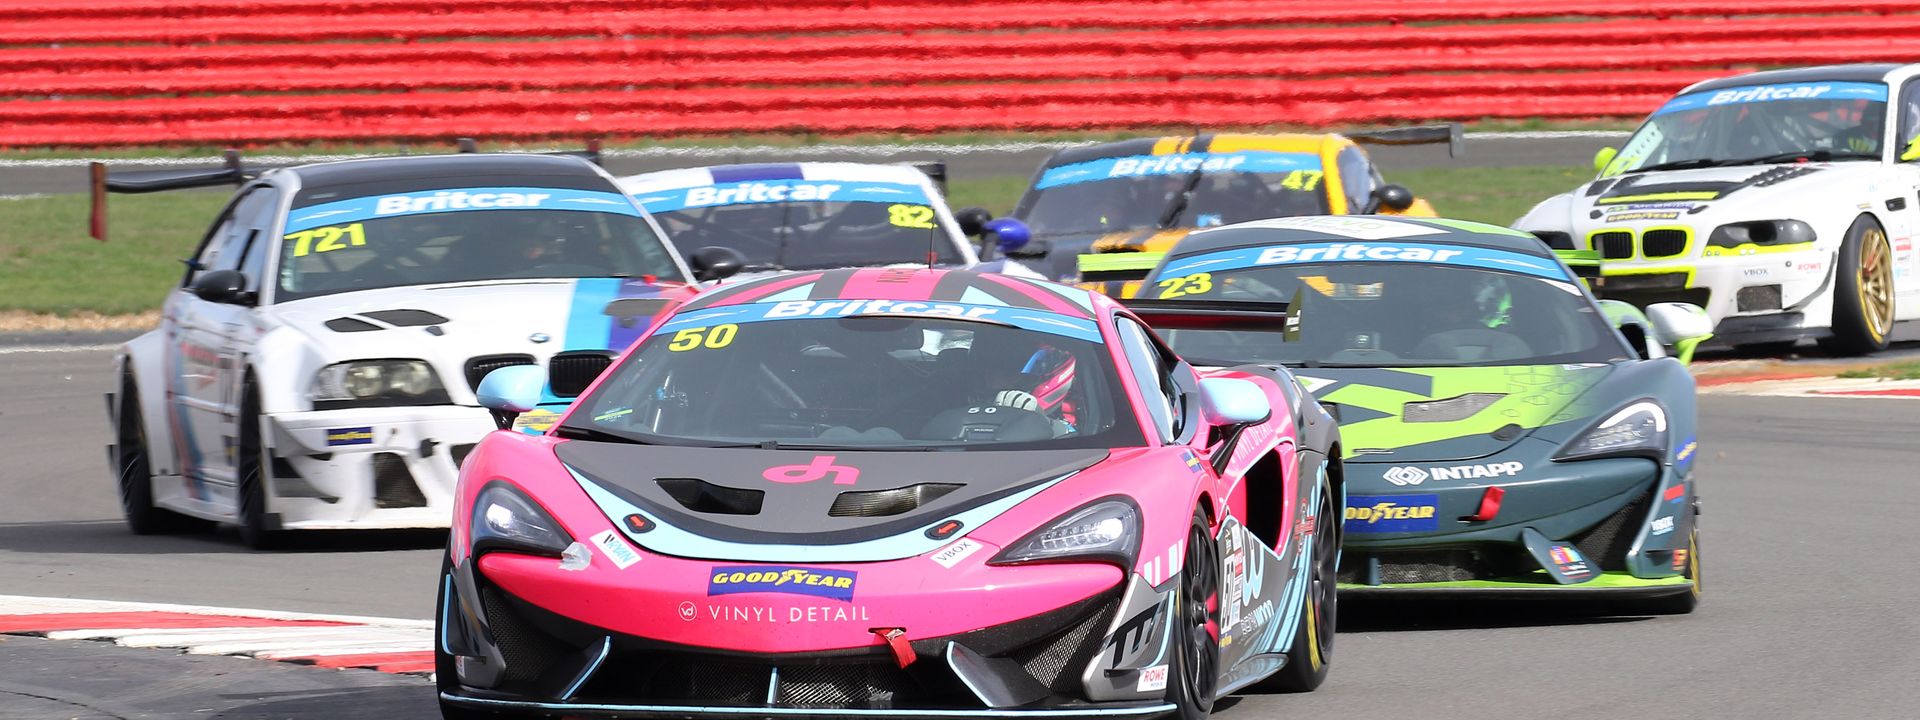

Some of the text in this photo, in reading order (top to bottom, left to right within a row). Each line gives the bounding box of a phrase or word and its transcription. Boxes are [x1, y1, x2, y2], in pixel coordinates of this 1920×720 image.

[1707, 84, 1831, 106] Britcar
[1109, 155, 1246, 178] Britcar
[1281, 169, 1323, 192] 47
[374, 192, 551, 216] Britcar
[683, 184, 841, 207] Britcar
[888, 203, 938, 230] 82
[284, 222, 367, 257] 721
[1254, 244, 1464, 265] Britcar
[1158, 272, 1213, 300] 23
[762, 299, 999, 318] Britcar
[668, 323, 739, 352] 50
[1429, 461, 1524, 481] INTAPP
[1345, 502, 1436, 524] ODYEAR
[936, 541, 972, 562] VBOX
[712, 569, 853, 589] GOODYEAR
[708, 605, 870, 623] VINYL DETAIL
[1143, 667, 1166, 683] ROWE
